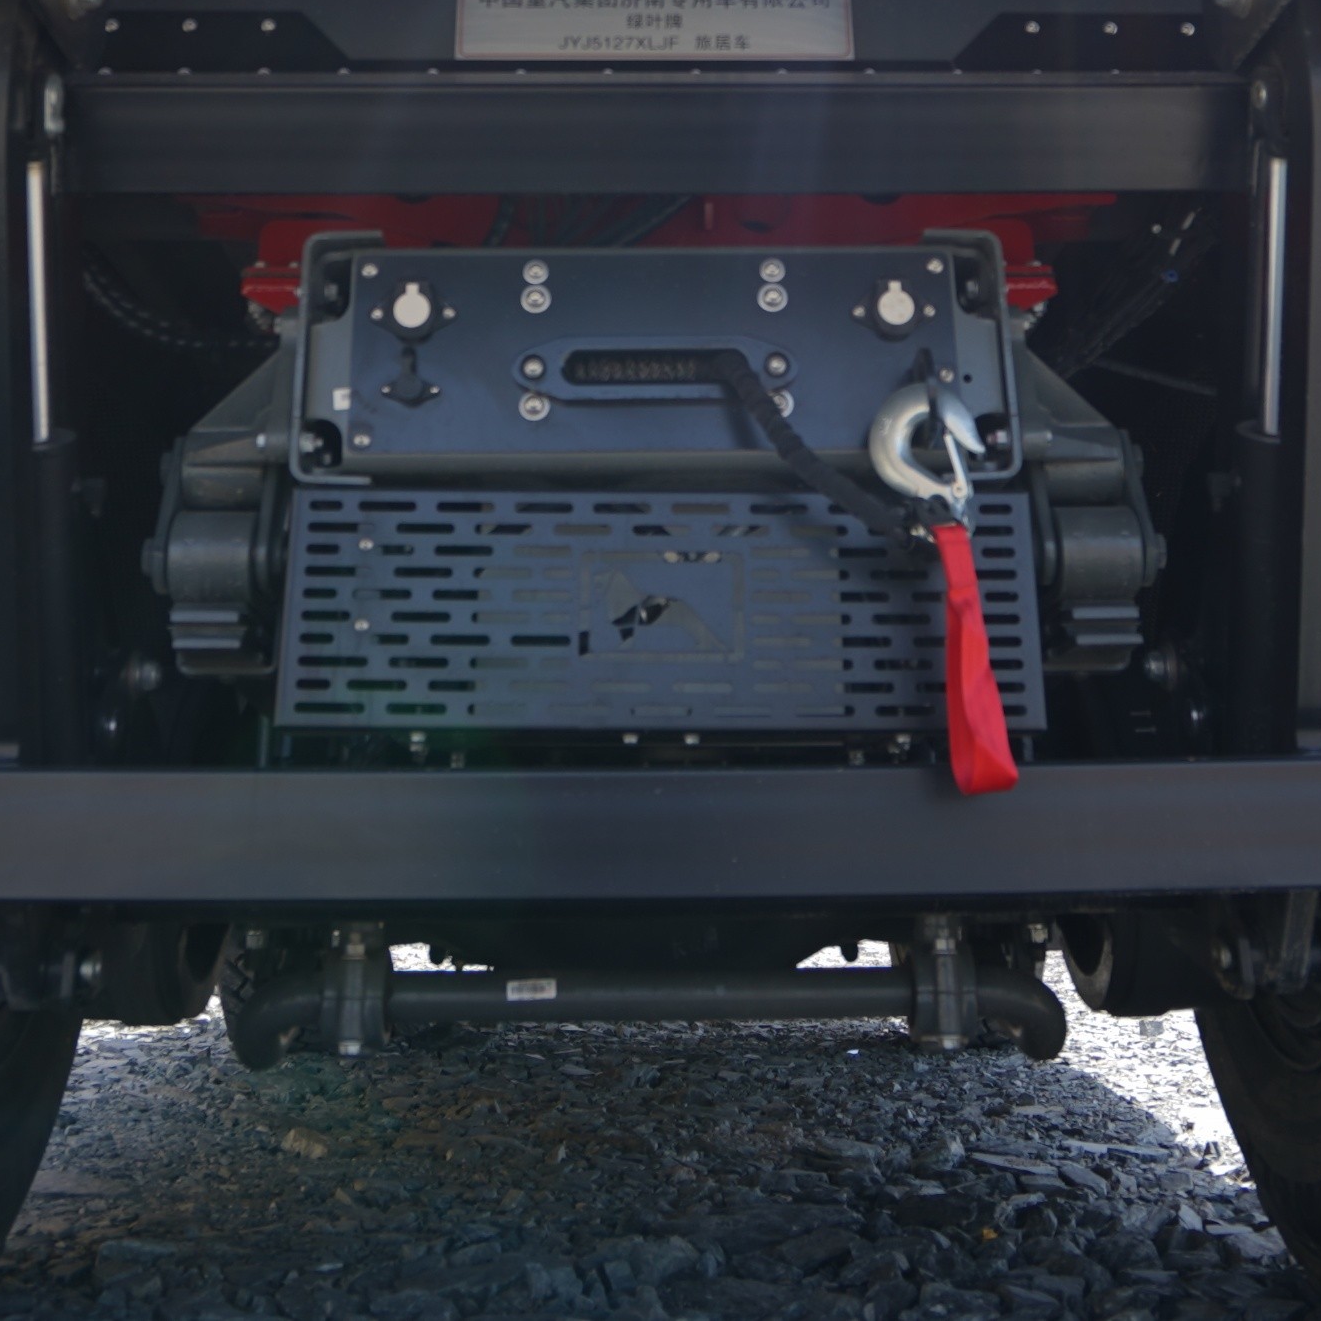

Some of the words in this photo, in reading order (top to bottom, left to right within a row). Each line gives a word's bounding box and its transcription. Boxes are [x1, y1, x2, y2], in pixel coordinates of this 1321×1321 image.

[625, 13, 684, 30] 绿叶牌
[558, 35, 680, 52] JYJ5127XLJF
[694, 34, 751, 52] 旅居车
